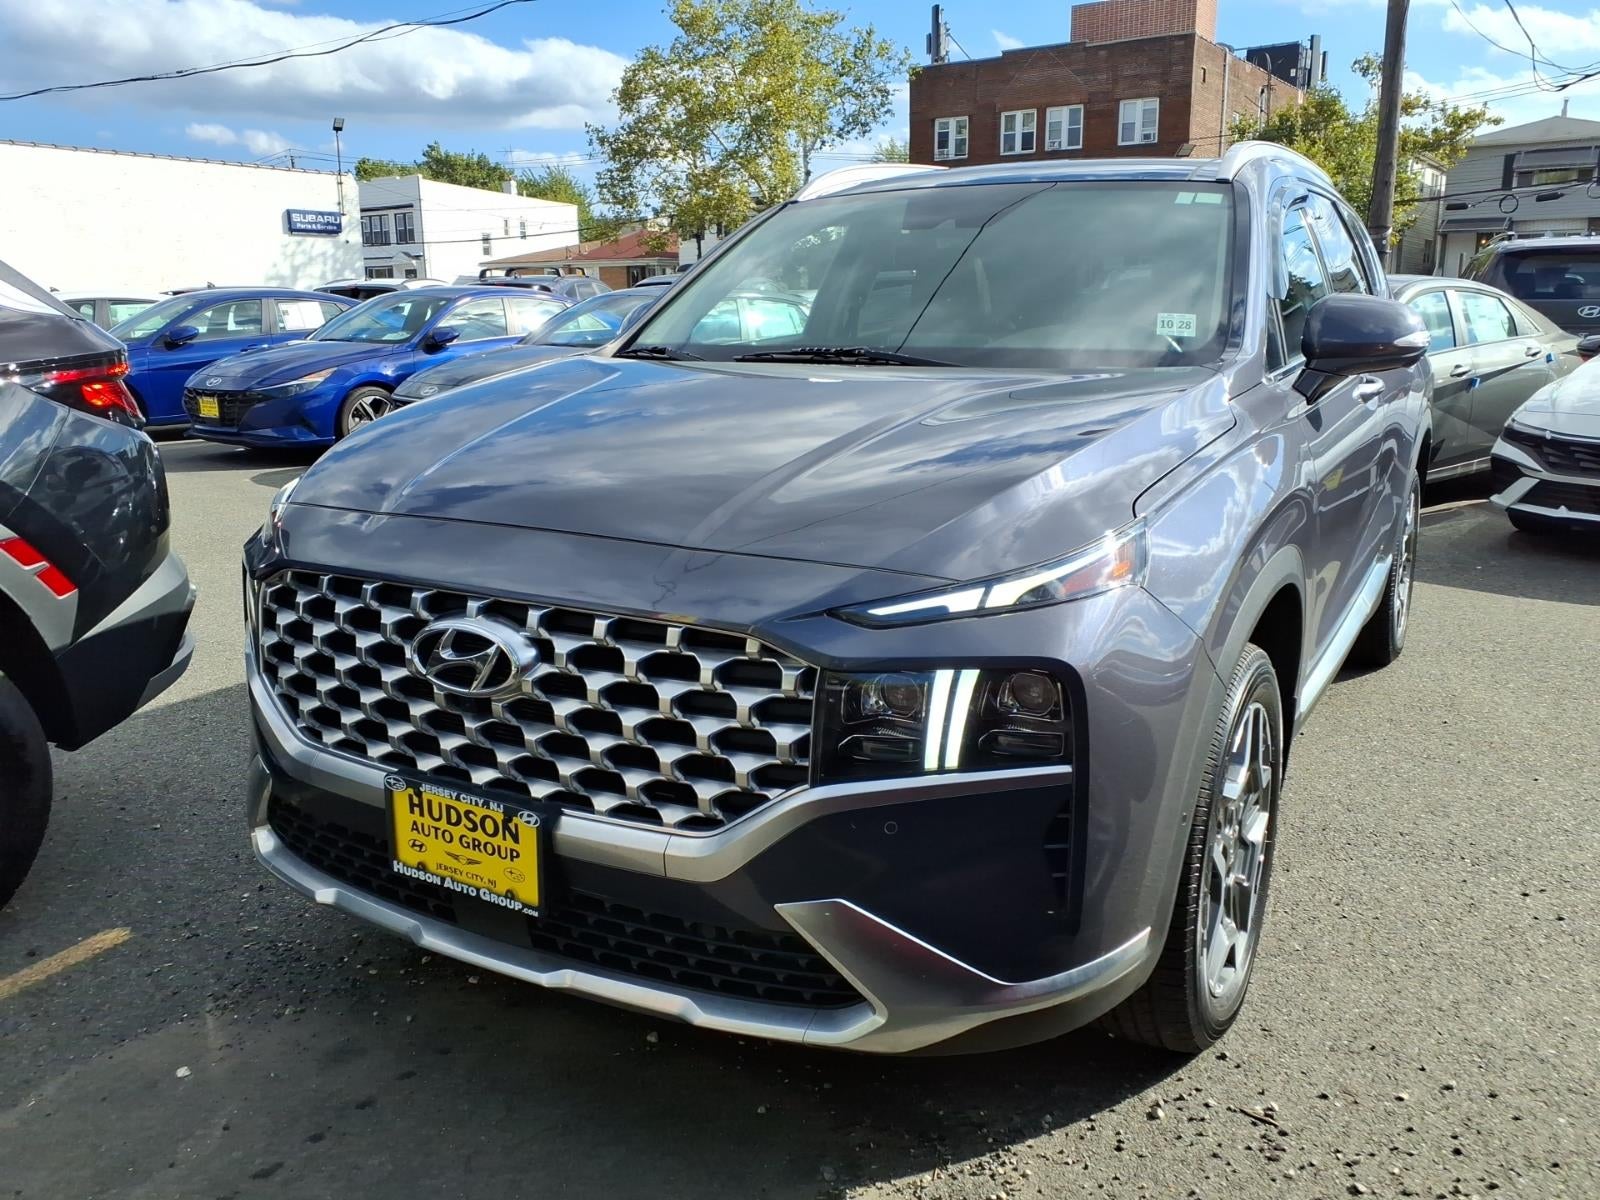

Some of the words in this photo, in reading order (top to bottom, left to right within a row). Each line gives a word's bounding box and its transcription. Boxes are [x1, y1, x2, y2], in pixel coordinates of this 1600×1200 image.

[292, 213, 340, 224] SUBARU
[1160, 319, 1174, 329] 10
[1178, 320, 1192, 330] 28
[419, 783, 458, 800] JERSEY
[459, 794, 487, 809] CITY,
[489, 802, 504, 812] NJ
[408, 793, 520, 845] HUDSON
[410, 820, 454, 844] AUTO
[458, 834, 521, 862] GROUP
[392, 860, 441, 885] HUDSON
[444, 877, 477, 897] AUTO
[436, 862, 465, 878] JERSEY
[487, 877, 497, 888] NJ
